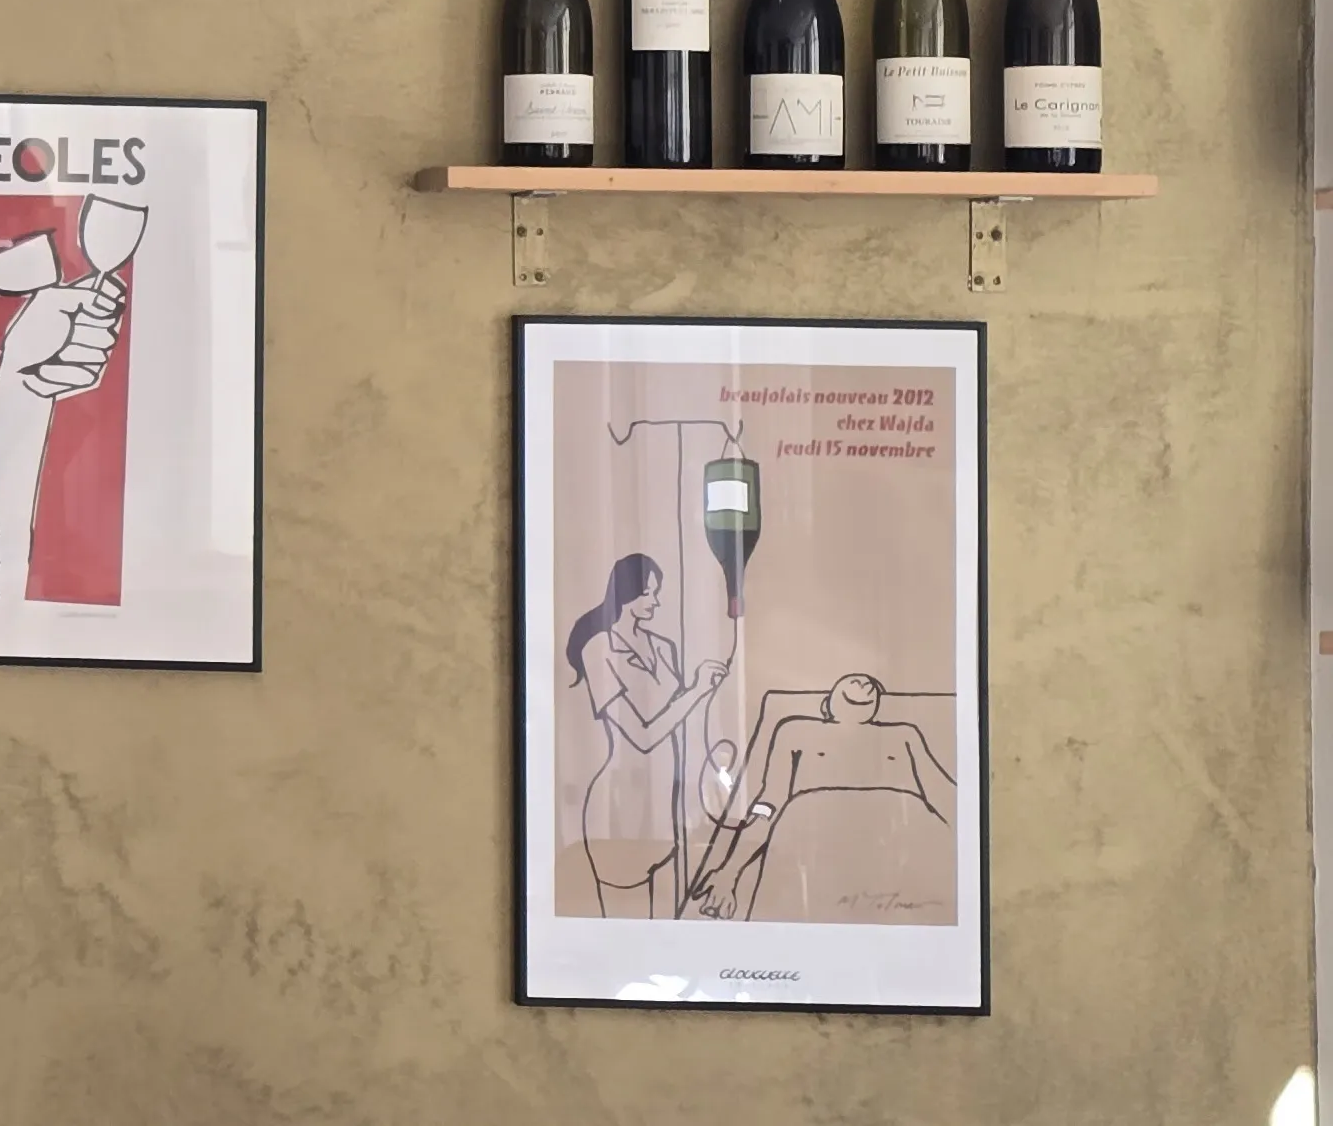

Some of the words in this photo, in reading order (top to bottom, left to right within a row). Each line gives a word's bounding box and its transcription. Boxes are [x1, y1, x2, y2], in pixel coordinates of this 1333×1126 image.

[898, 65, 926, 78] Petit
[1014, 98, 1029, 111] Le
[719, 386, 810, 408] beaujolais
[814, 388, 889, 407] nouveau
[893, 387, 935, 407] 2012
[836, 414, 874, 432] chez
[879, 414, 935, 435] Wajda
[776, 439, 822, 459] jeudi
[825, 440, 842, 457] 15
[846, 441, 936, 459] novembre
